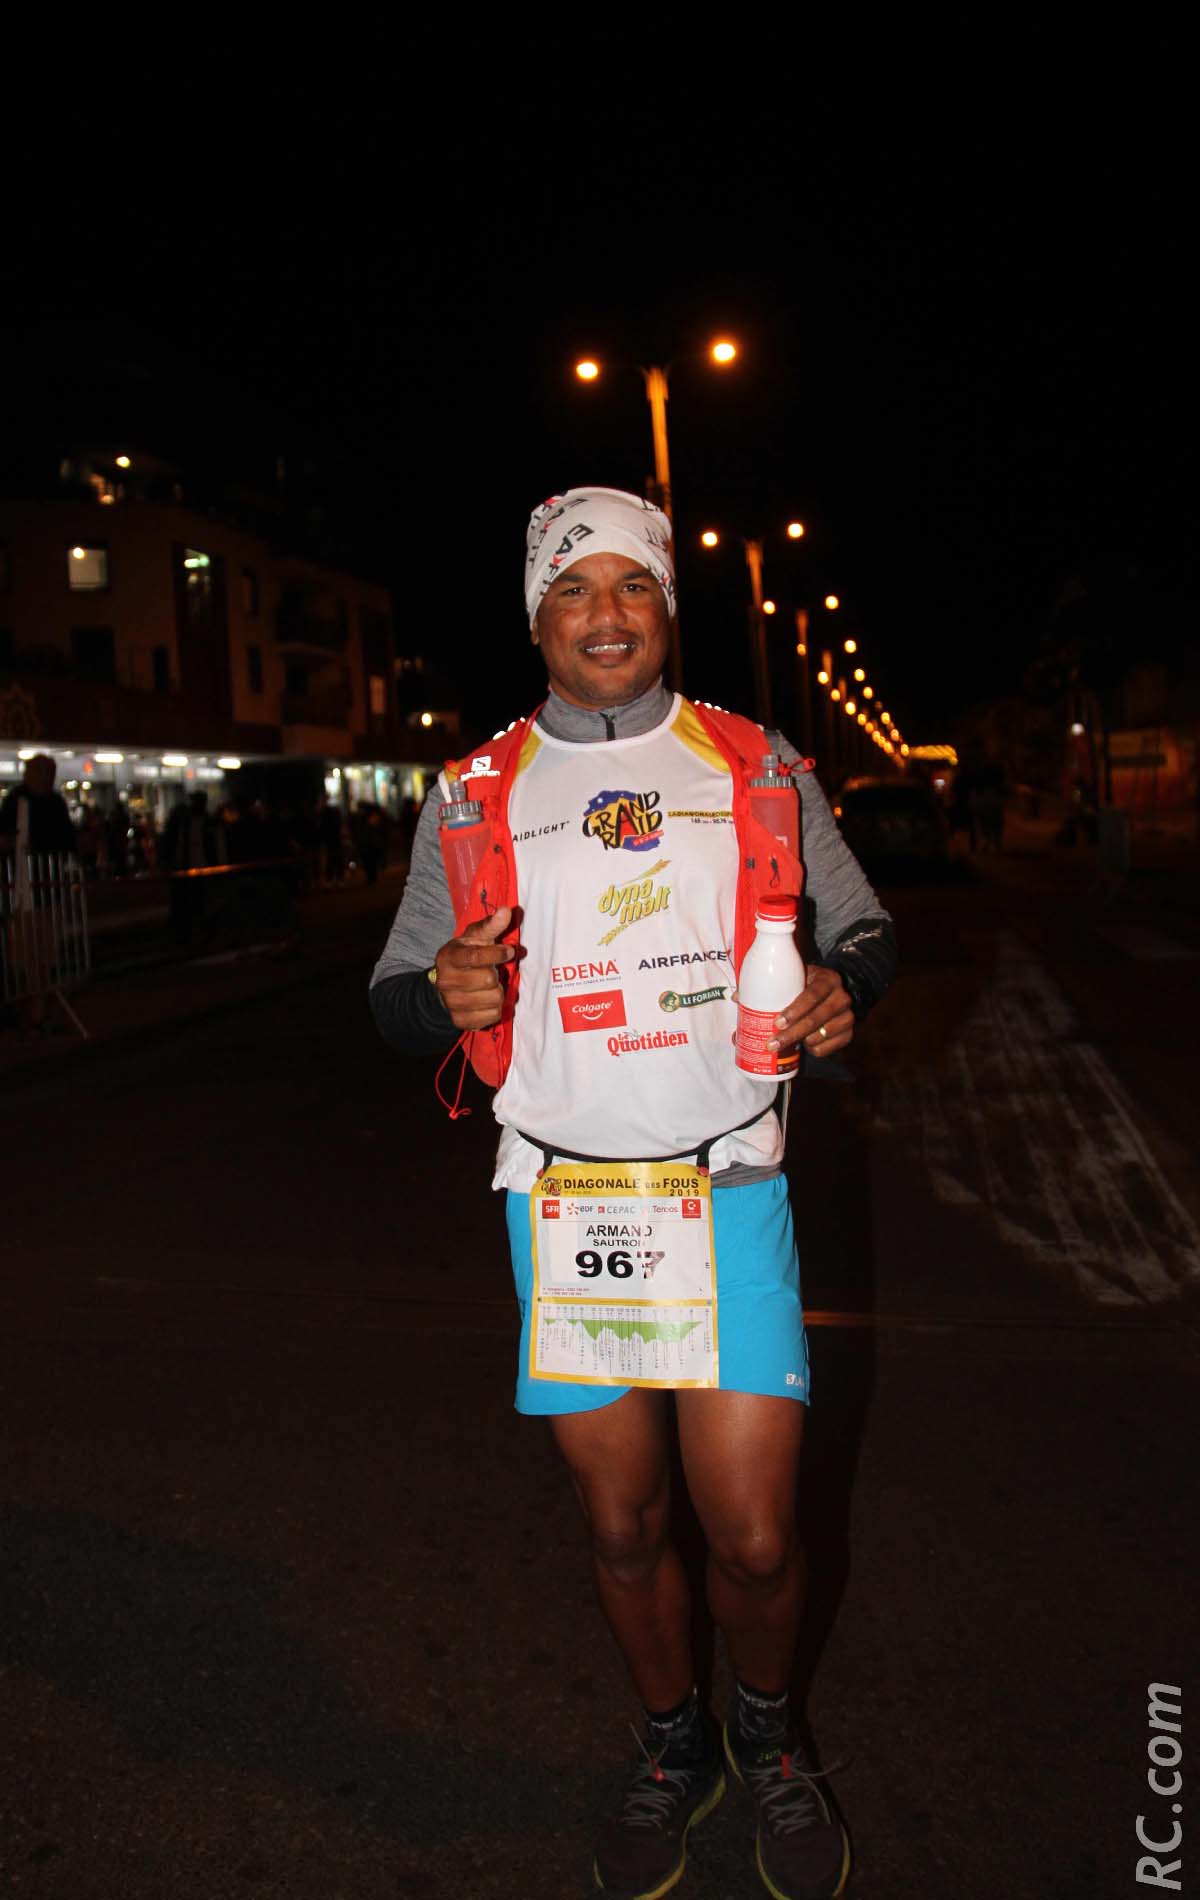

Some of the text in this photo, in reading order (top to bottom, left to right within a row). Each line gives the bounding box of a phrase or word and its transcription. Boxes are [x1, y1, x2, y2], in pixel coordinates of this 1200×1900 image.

[598, 880, 653, 917] dyna
[619, 887, 671, 924] malt
[552, 960, 619, 982] EDENA
[572, 1001, 612, 1014] Colgate
[607, 1030, 689, 1056] Quotidien
[563, 1178, 640, 1189] DIAGONALE
[663, 1178, 699, 1189] FOUS
[669, 1188, 699, 1197] 2019
[607, 1205, 636, 1214] CEPAC
[586, 1224, 653, 1237] ARMAND
[575, 1250, 665, 1279] 967
